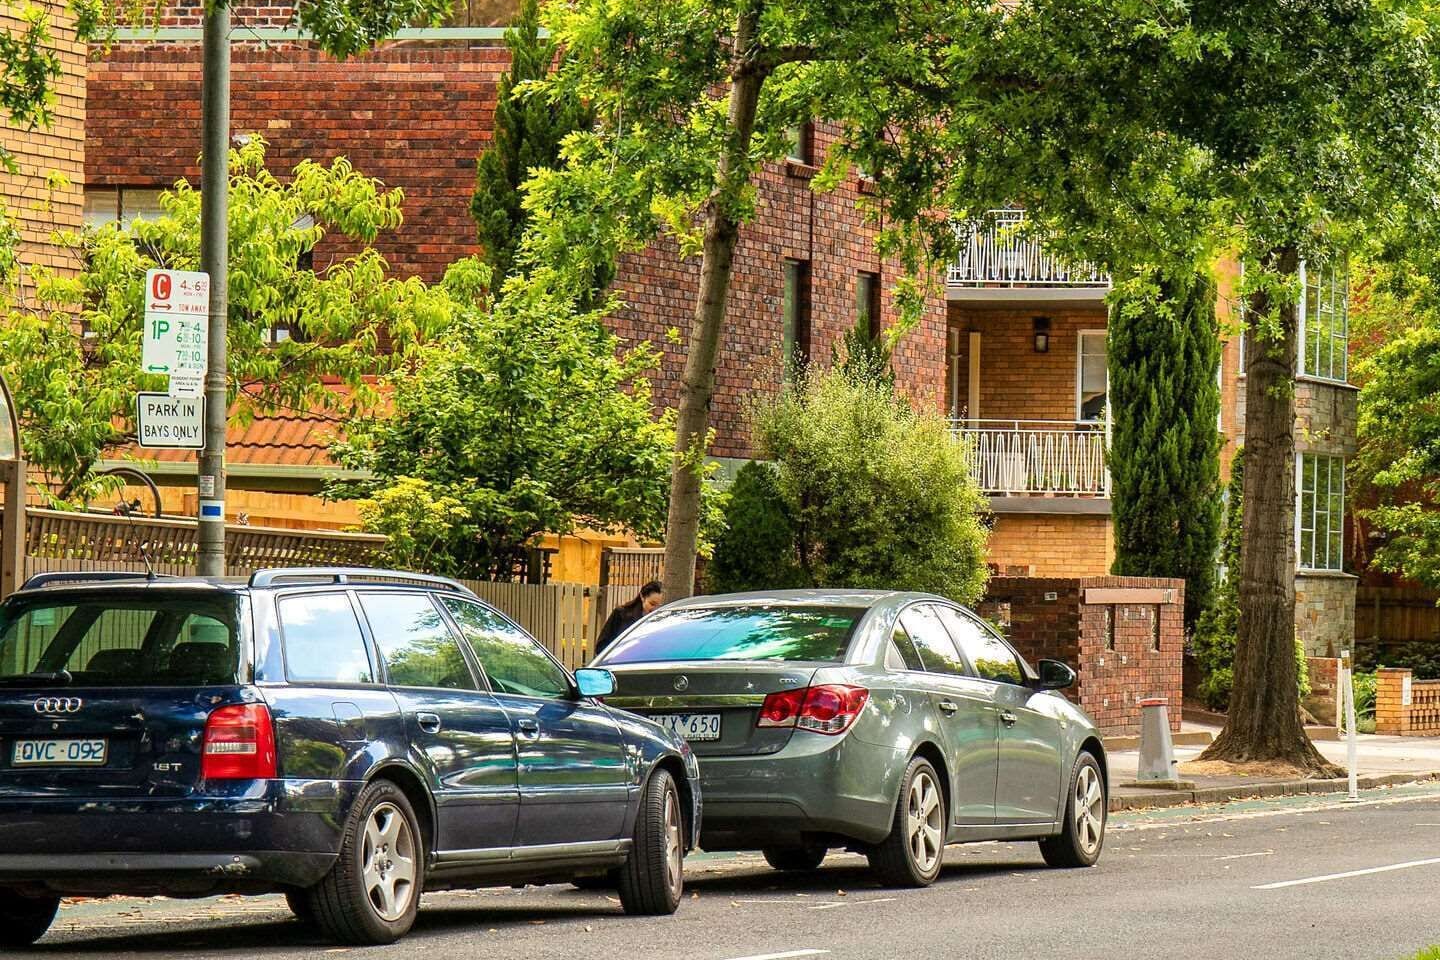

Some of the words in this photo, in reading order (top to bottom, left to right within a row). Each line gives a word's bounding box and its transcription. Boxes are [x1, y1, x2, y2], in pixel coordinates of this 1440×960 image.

[178, 303, 189, 312] TOW
[190, 304, 206, 313] AWAY
[152, 320, 170, 340] 1P
[147, 403, 179, 416] PARK
[183, 404, 195, 417] IN
[144, 424, 170, 438] BAYS
[172, 425, 199, 438] ONLY
[690, 716, 719, 734] 650
